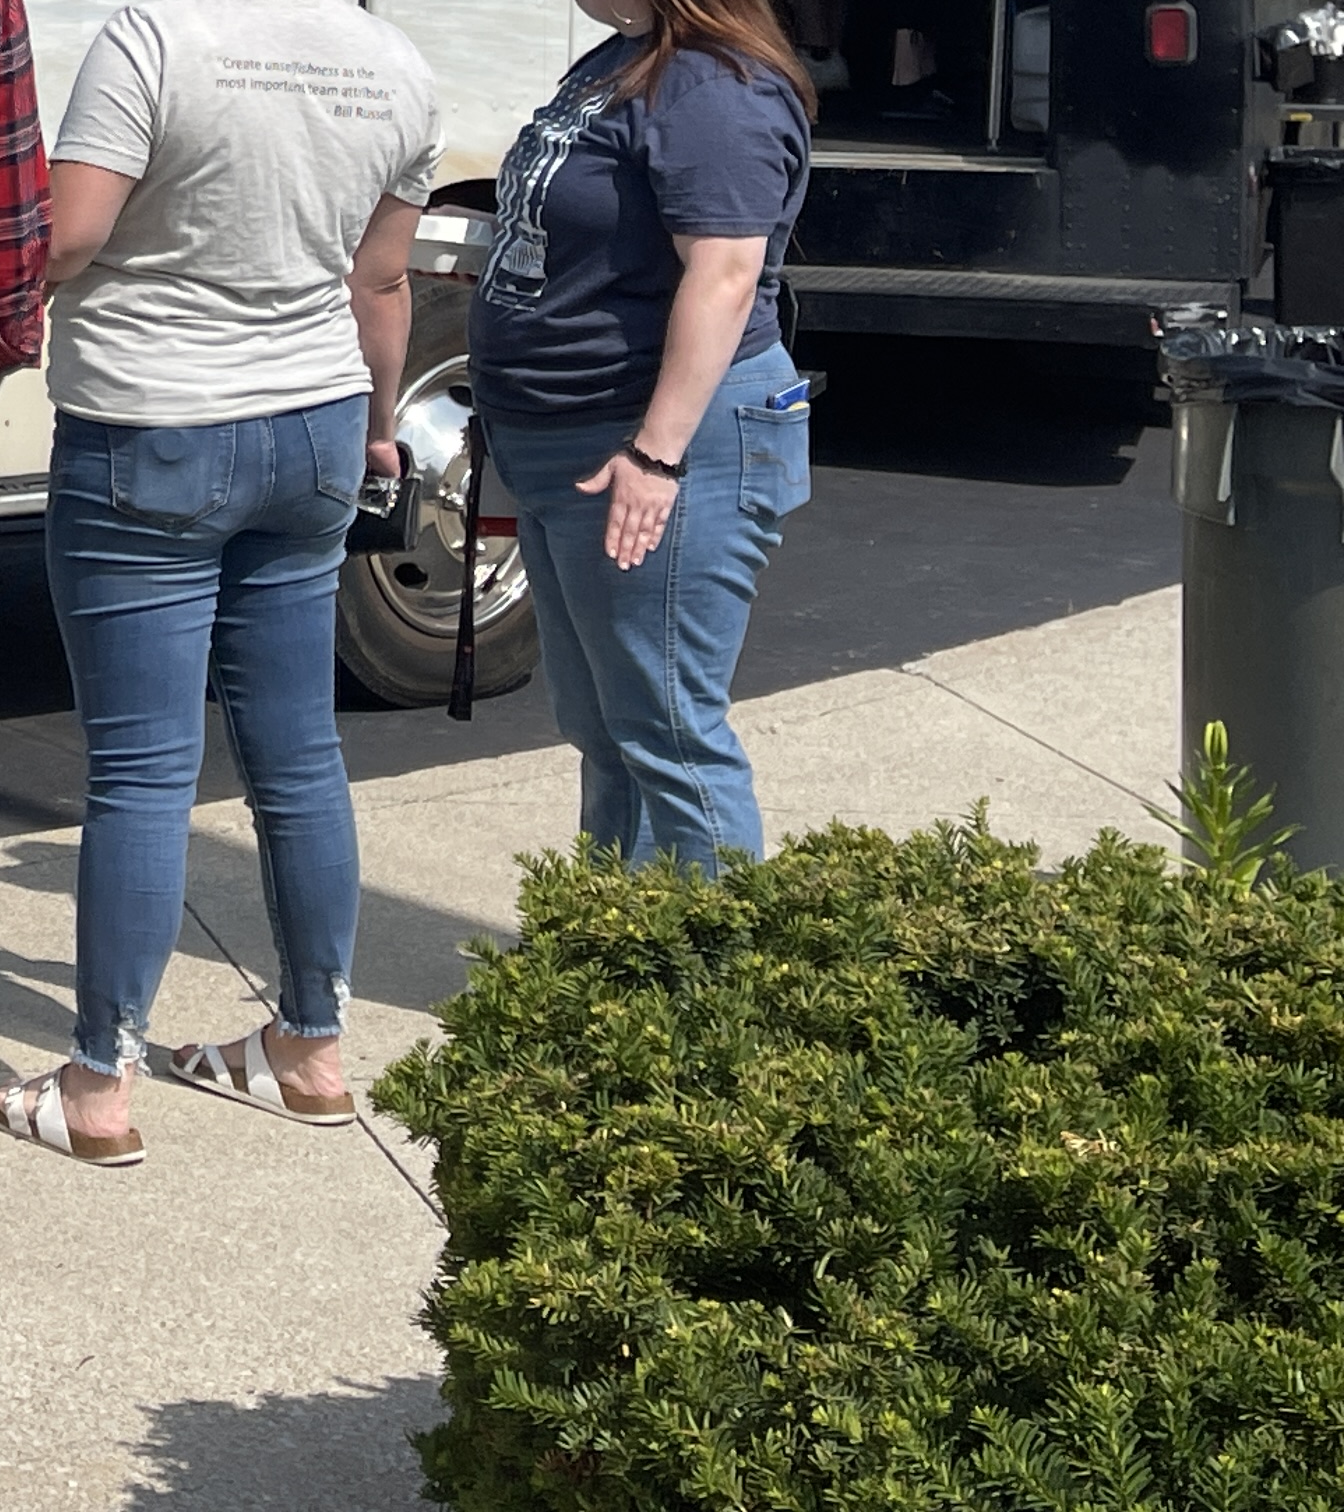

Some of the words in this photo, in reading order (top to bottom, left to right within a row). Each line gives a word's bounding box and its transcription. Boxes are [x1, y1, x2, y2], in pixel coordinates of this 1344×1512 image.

[342, 68, 355, 78] as
[356, 66, 376, 81] the
[215, 78, 247, 90] most
[250, 78, 306, 93] important
[307, 83, 339, 97] team
[334, 104, 353, 118] Bill
[356, 106, 393, 121] Russell
